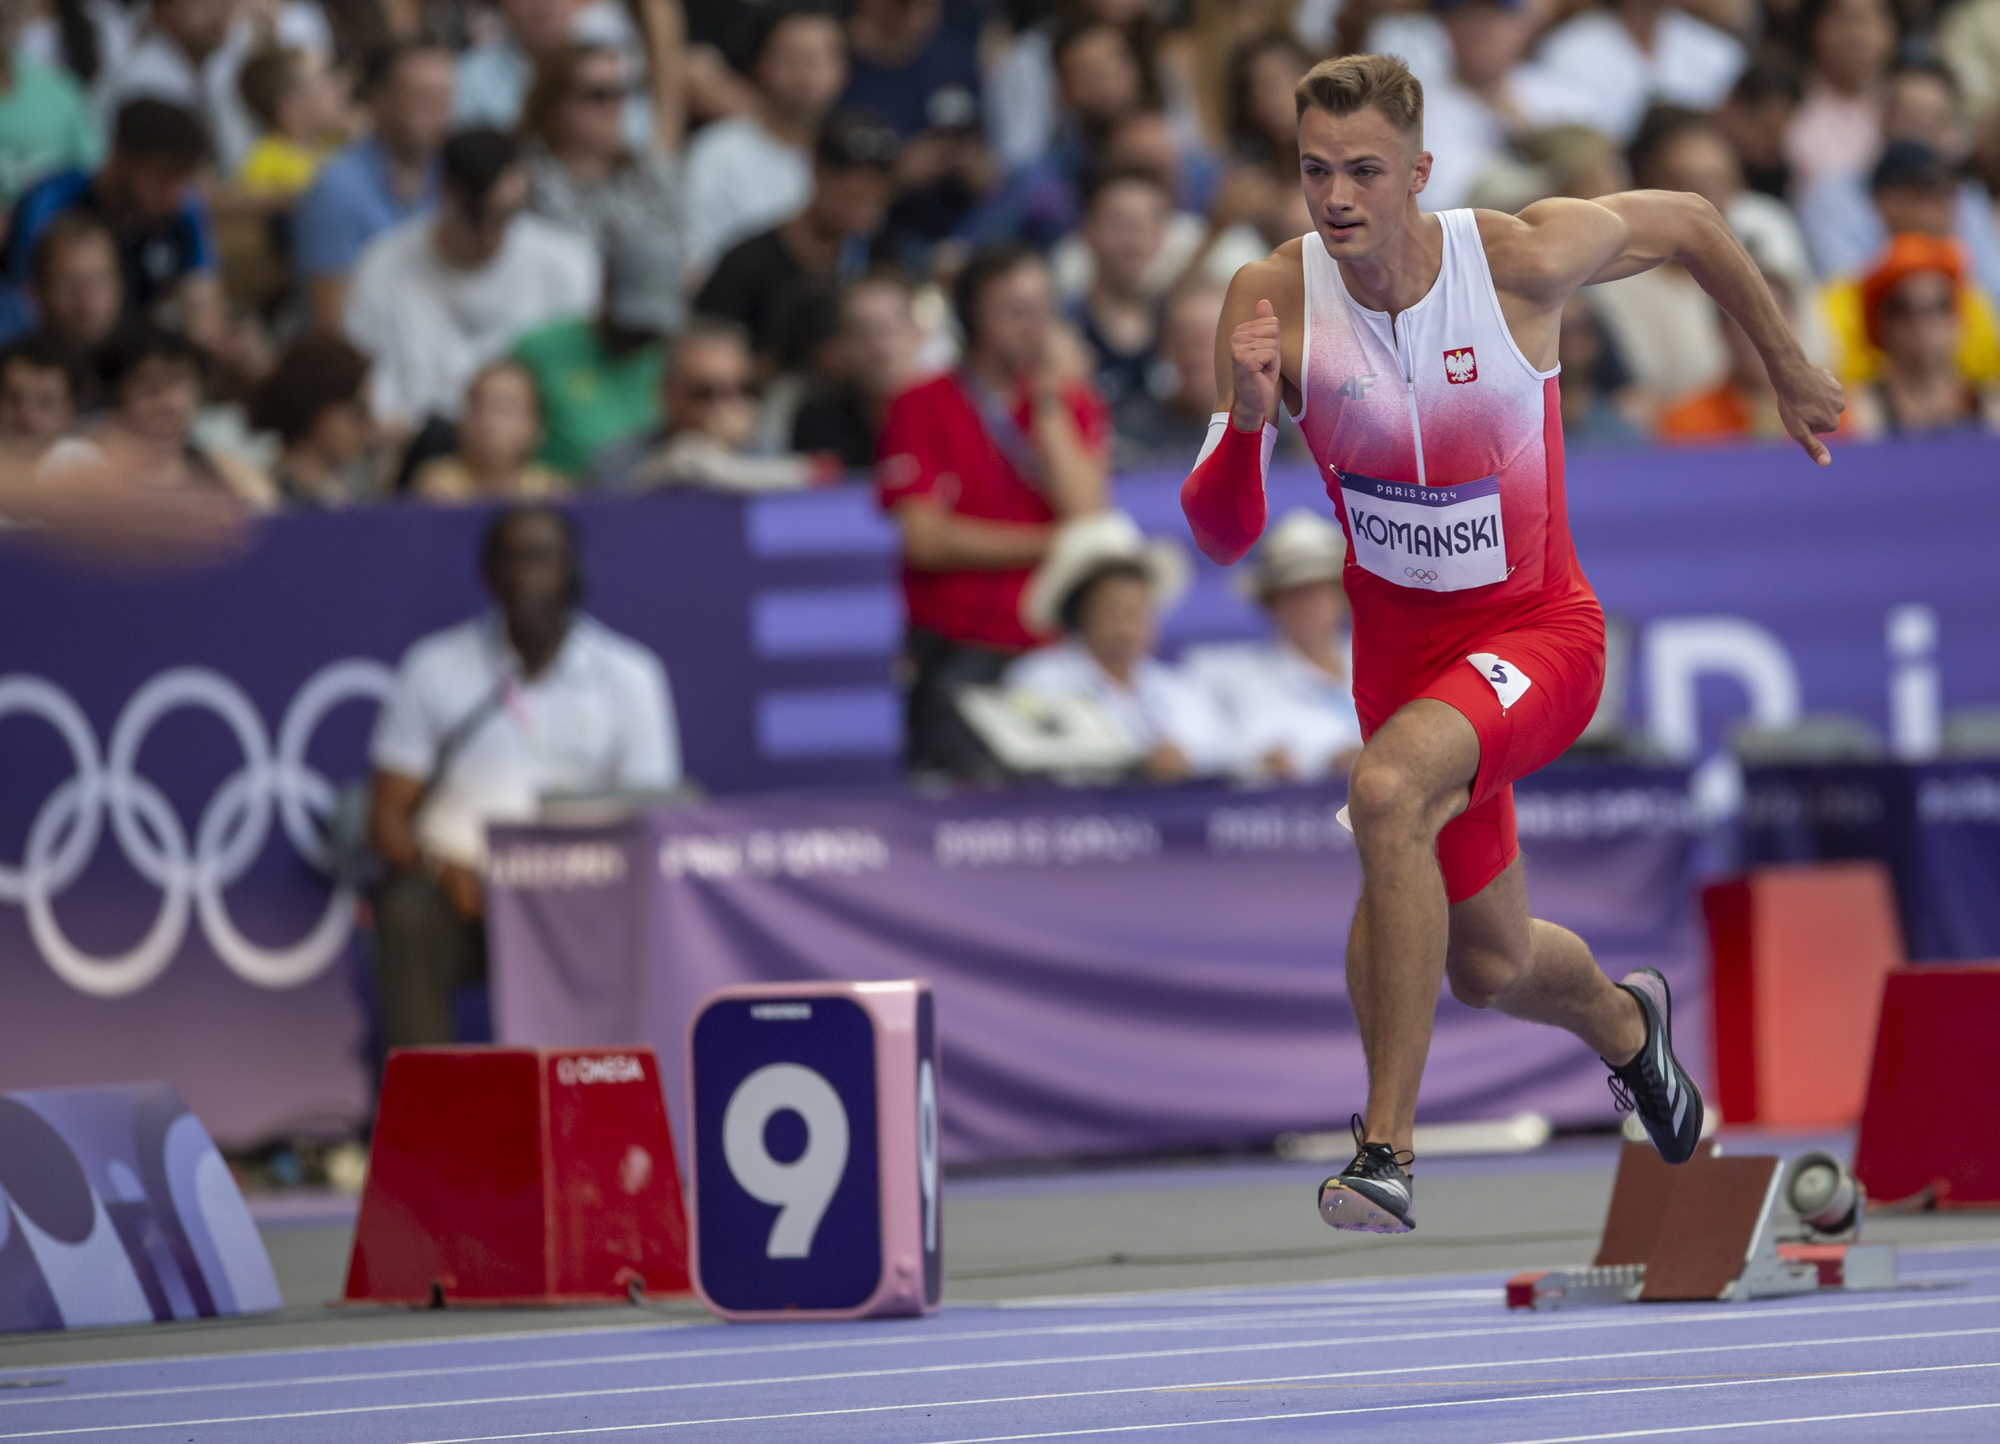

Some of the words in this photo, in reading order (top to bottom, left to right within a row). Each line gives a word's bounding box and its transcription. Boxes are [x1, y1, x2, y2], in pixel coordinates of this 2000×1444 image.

[1336, 373, 1378, 400] 4F
[1420, 491, 1457, 502] 2024
[1351, 506, 1498, 557] KOMANSKI
[1490, 664, 1508, 684] 5
[722, 1062, 850, 1258] 9
